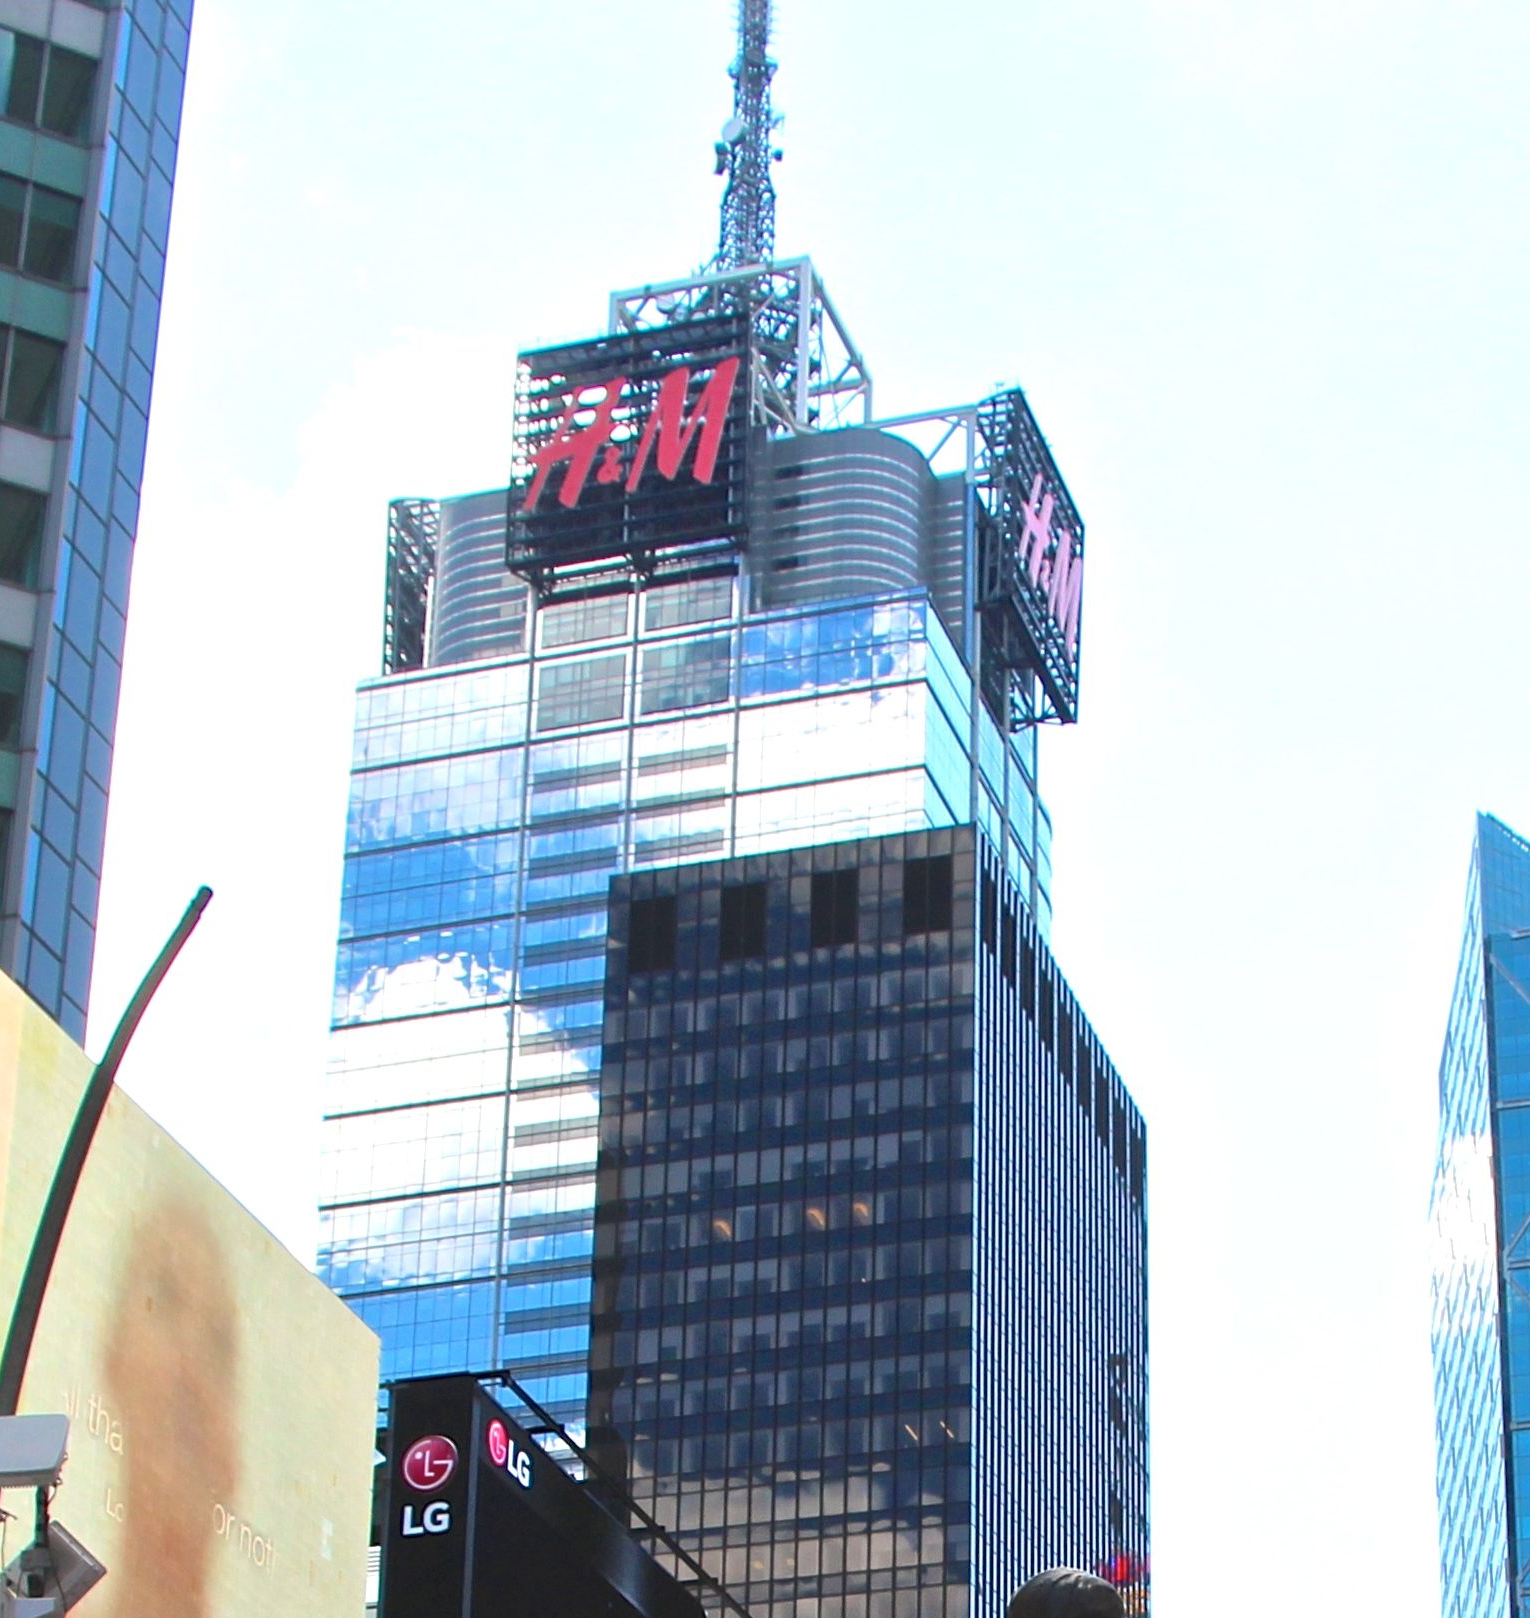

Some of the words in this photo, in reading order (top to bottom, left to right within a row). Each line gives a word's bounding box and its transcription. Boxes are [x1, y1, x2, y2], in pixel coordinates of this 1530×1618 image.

[522, 355, 741, 513] H&M
[506, 1437, 534, 1490] LG
[400, 1501, 452, 1538] LG
